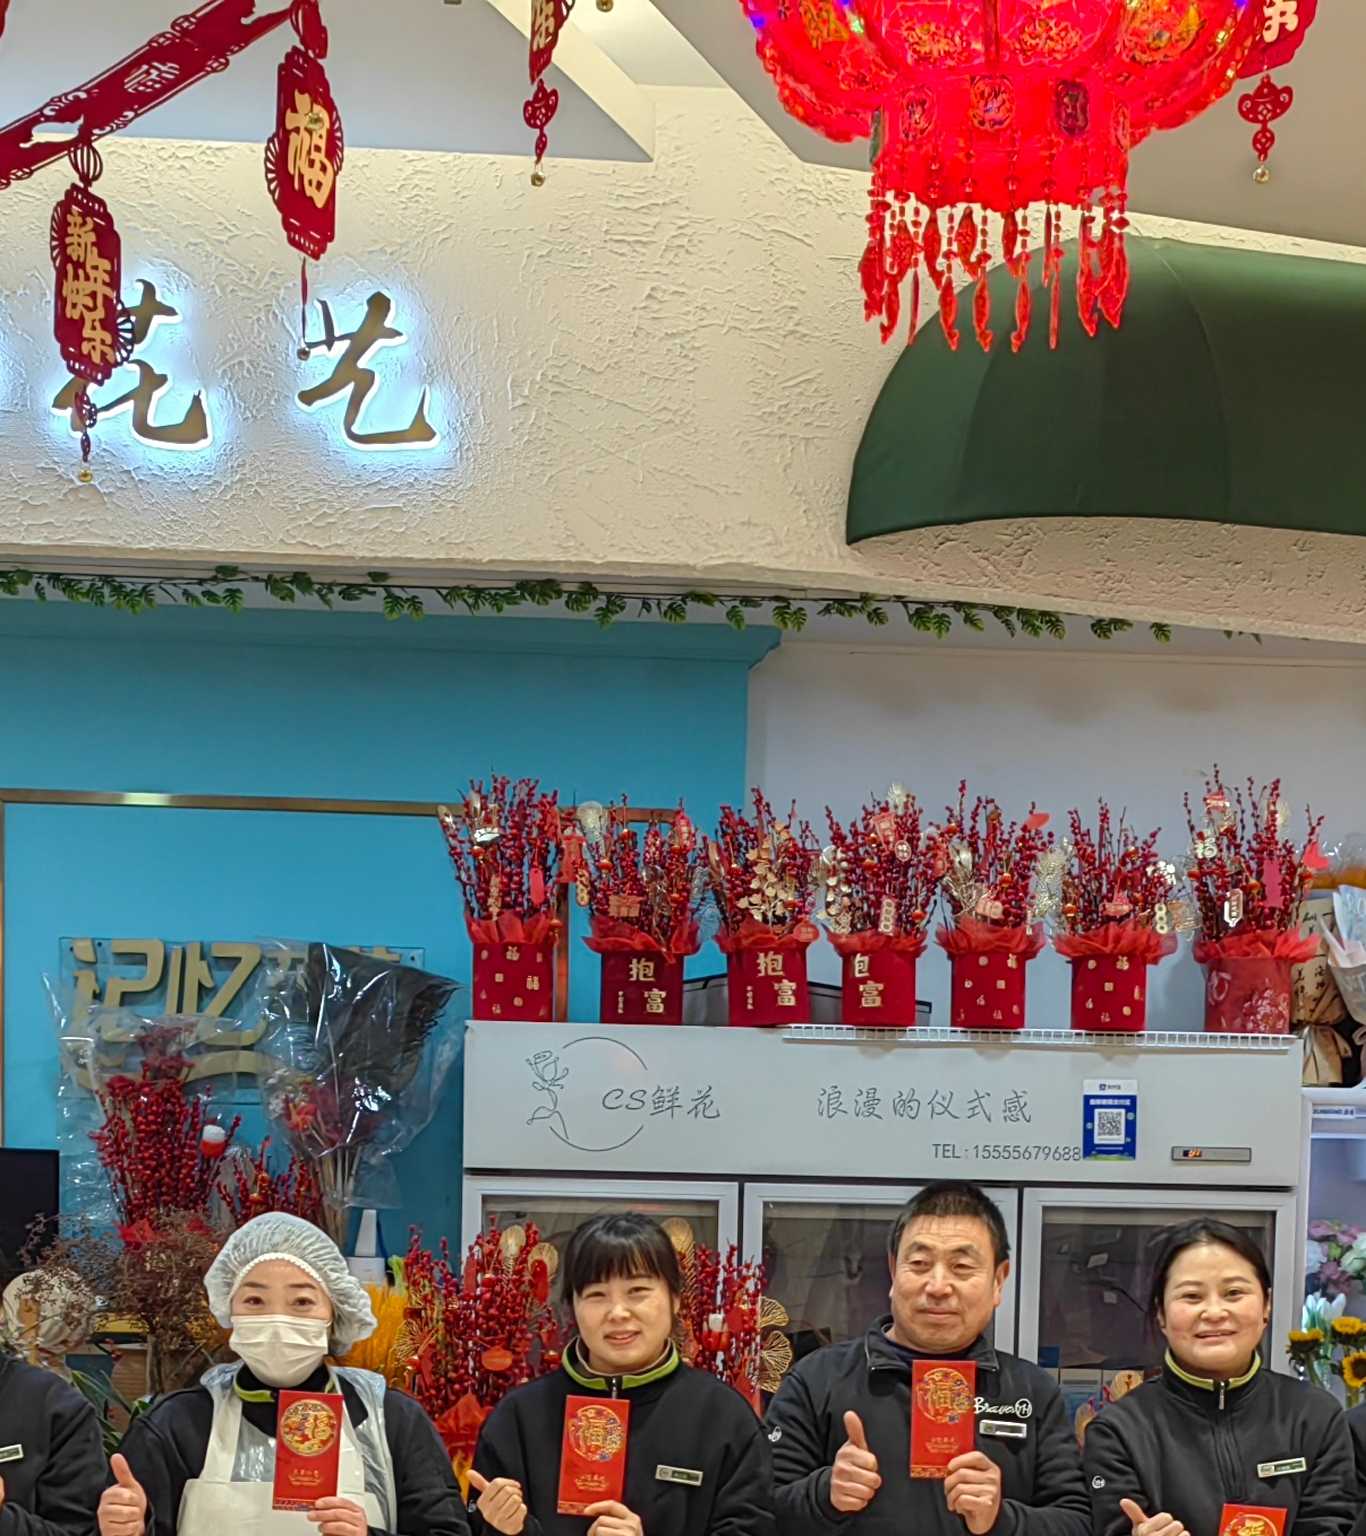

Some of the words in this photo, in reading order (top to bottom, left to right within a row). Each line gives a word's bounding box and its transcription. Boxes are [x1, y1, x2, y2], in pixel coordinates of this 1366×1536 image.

[285, 92, 336, 208] 福
[60, 211, 116, 365] 新年快乐
[816, 1085, 1033, 1124] 浪漫的仪式感
[973, 1396, 1016, 1415] Bravo
